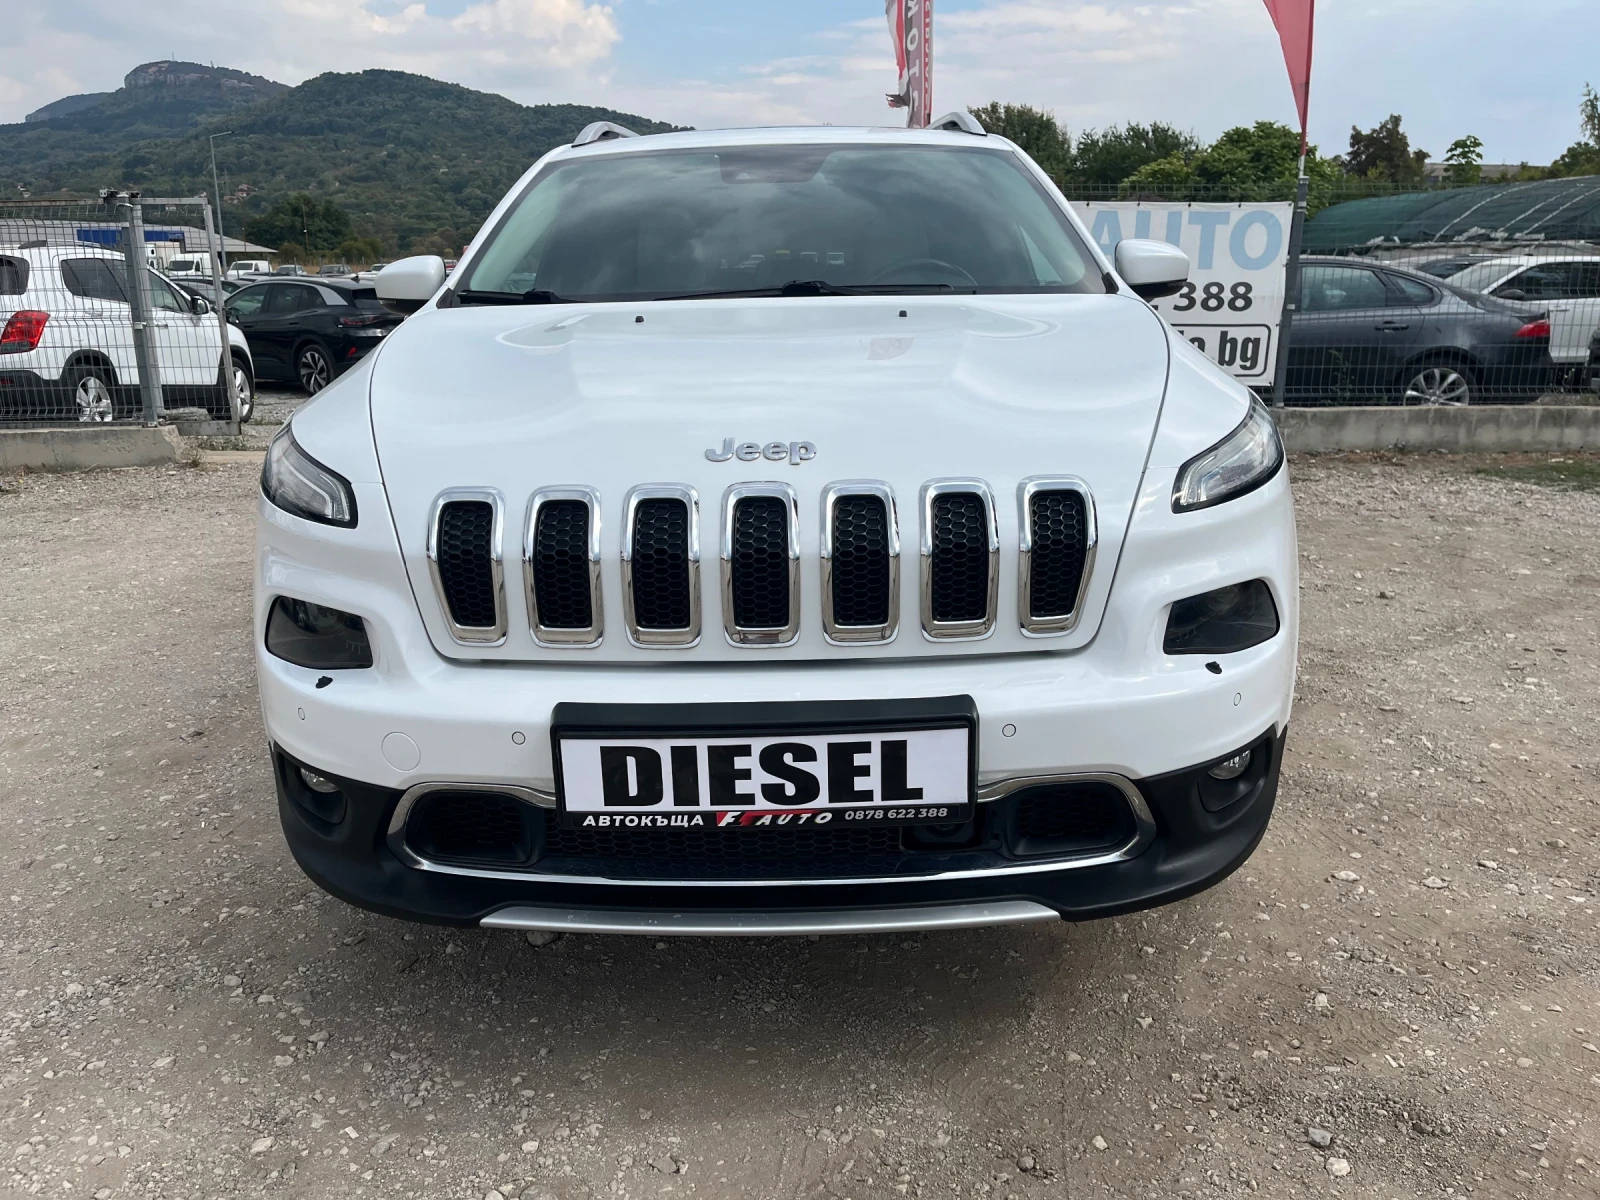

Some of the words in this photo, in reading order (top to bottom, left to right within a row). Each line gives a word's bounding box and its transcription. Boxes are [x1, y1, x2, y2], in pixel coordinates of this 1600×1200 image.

[1090, 210, 1283, 271] AUTO
[1173, 281, 1253, 312] 388
[704, 437, 818, 466] Jeep
[599, 739, 924, 807] DIESEL
[582, 814, 704, 828] АВТОКЪЩА
[755, 812, 834, 827] AUTO
[844, 809, 884, 821] 0878
[887, 808, 916, 819] 622
[918, 807, 948, 818] 388
